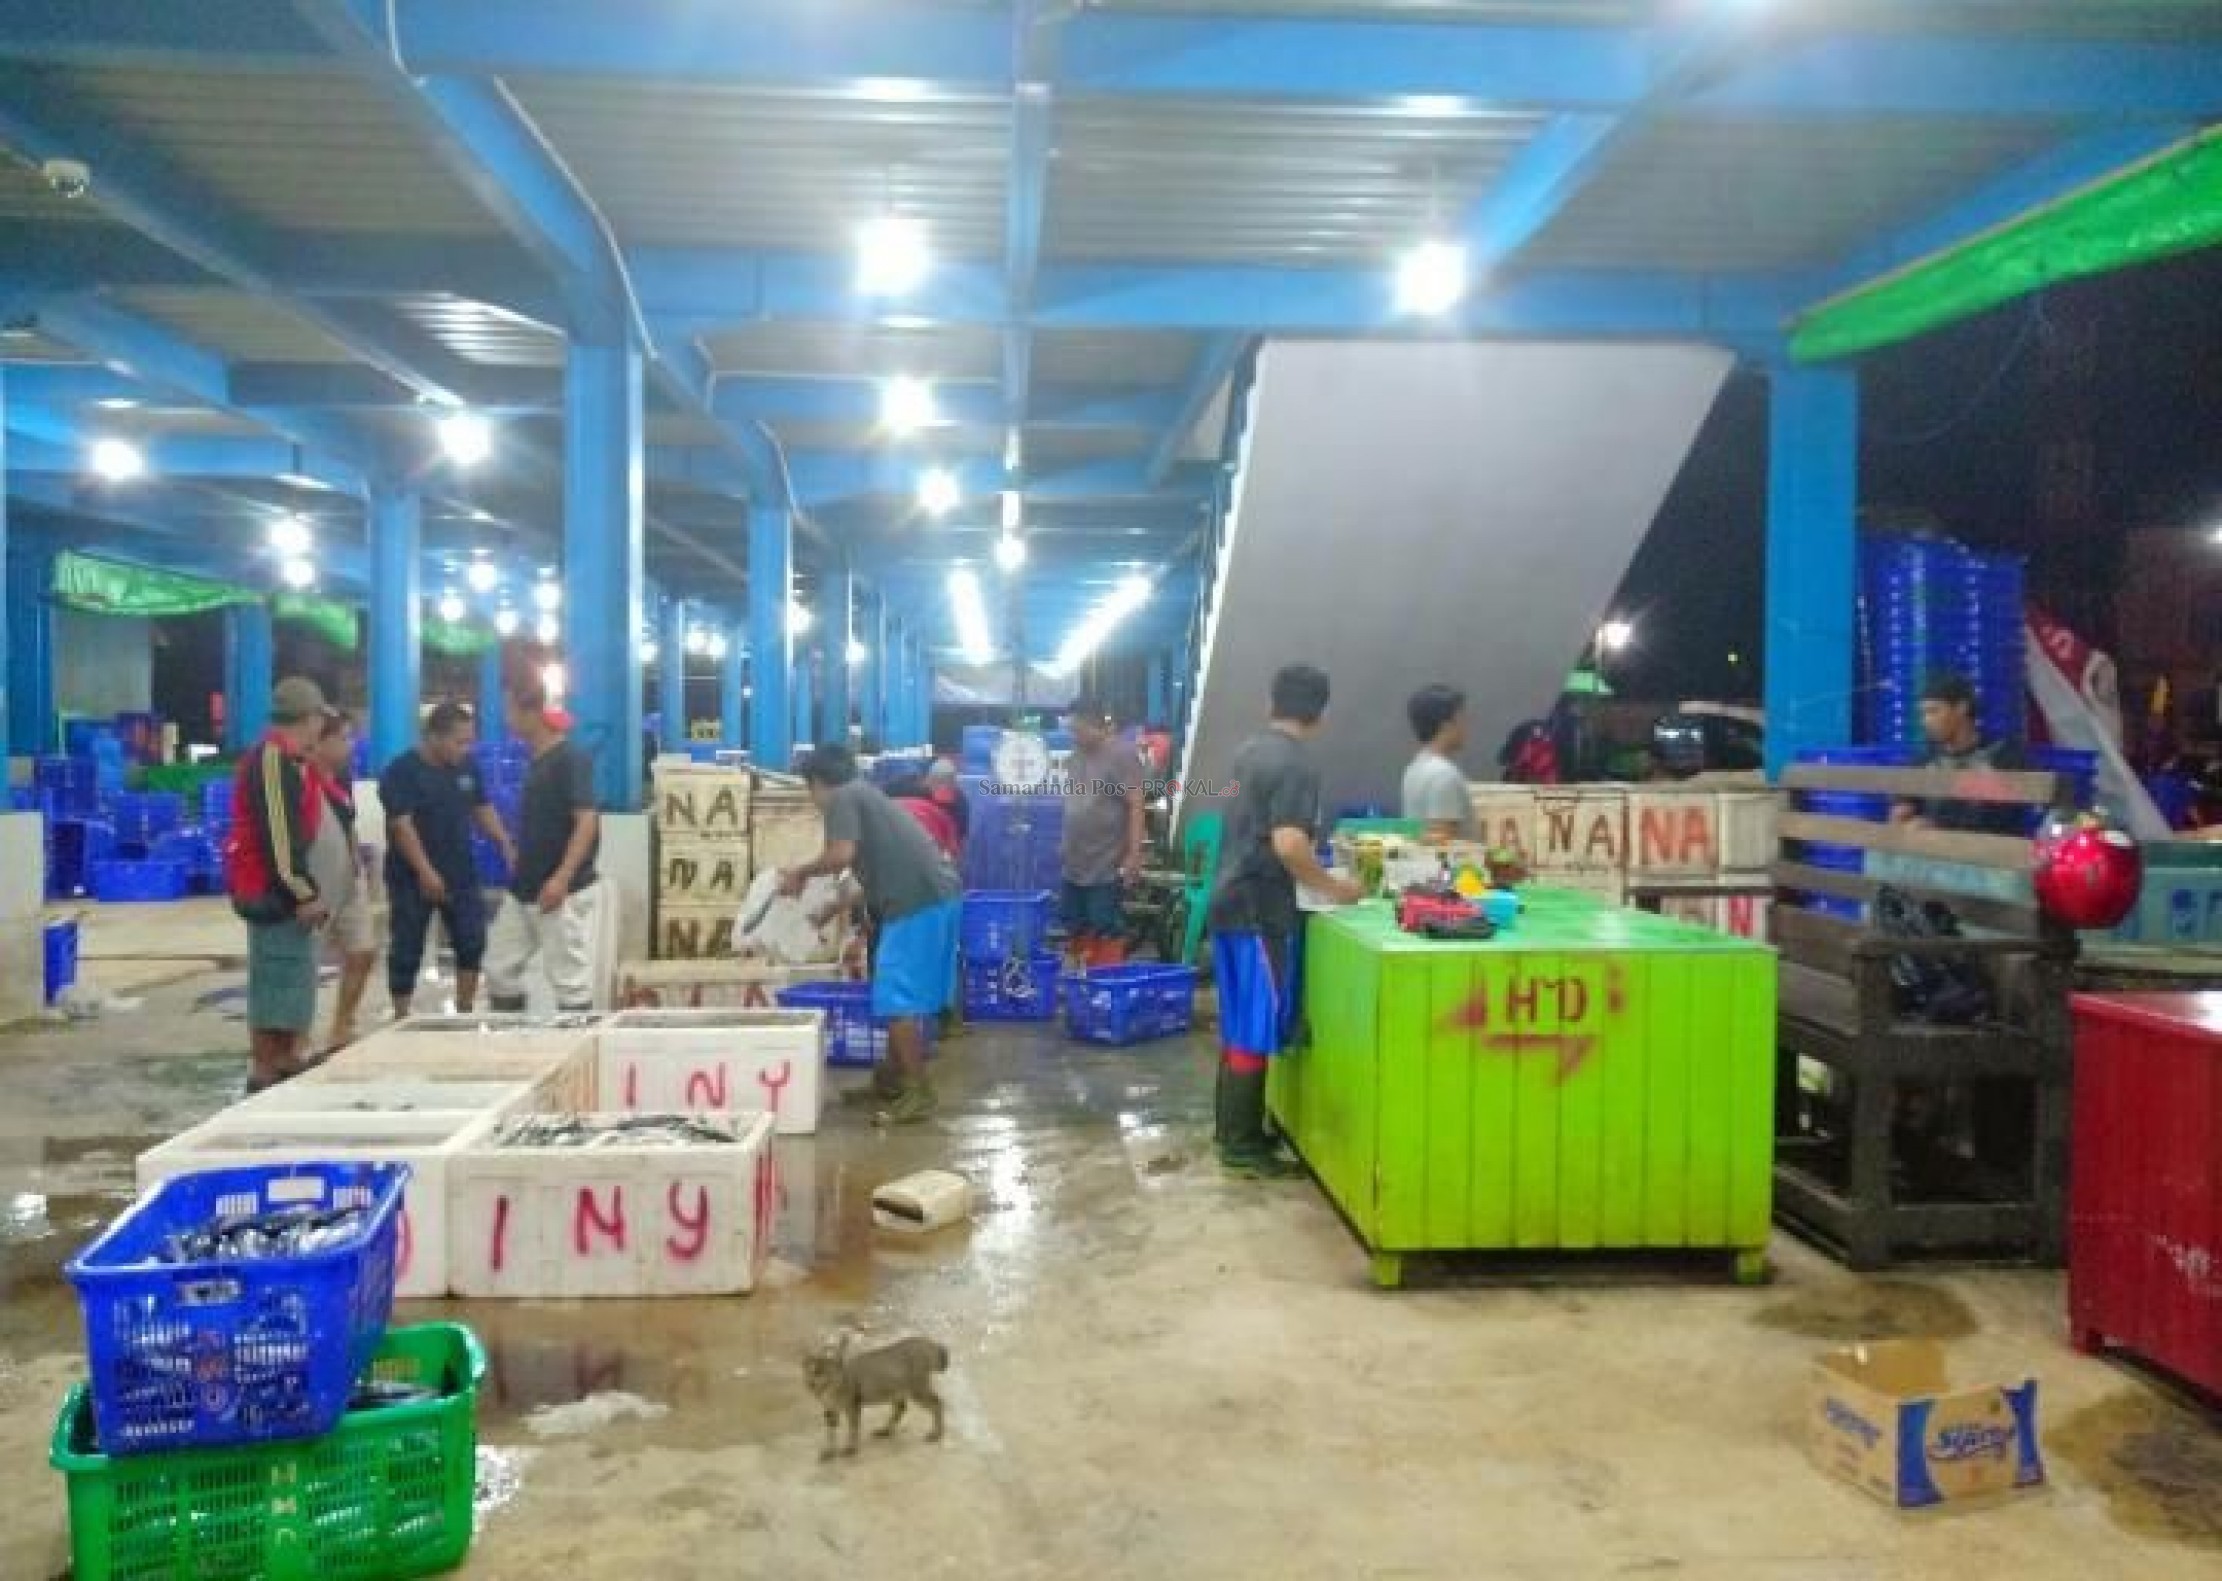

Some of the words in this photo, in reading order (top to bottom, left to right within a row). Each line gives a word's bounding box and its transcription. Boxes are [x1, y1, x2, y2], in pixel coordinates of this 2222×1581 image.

[666, 785, 738, 826] NA
[1639, 806, 1712, 866] NA
[491, 1179, 710, 1272] INY
